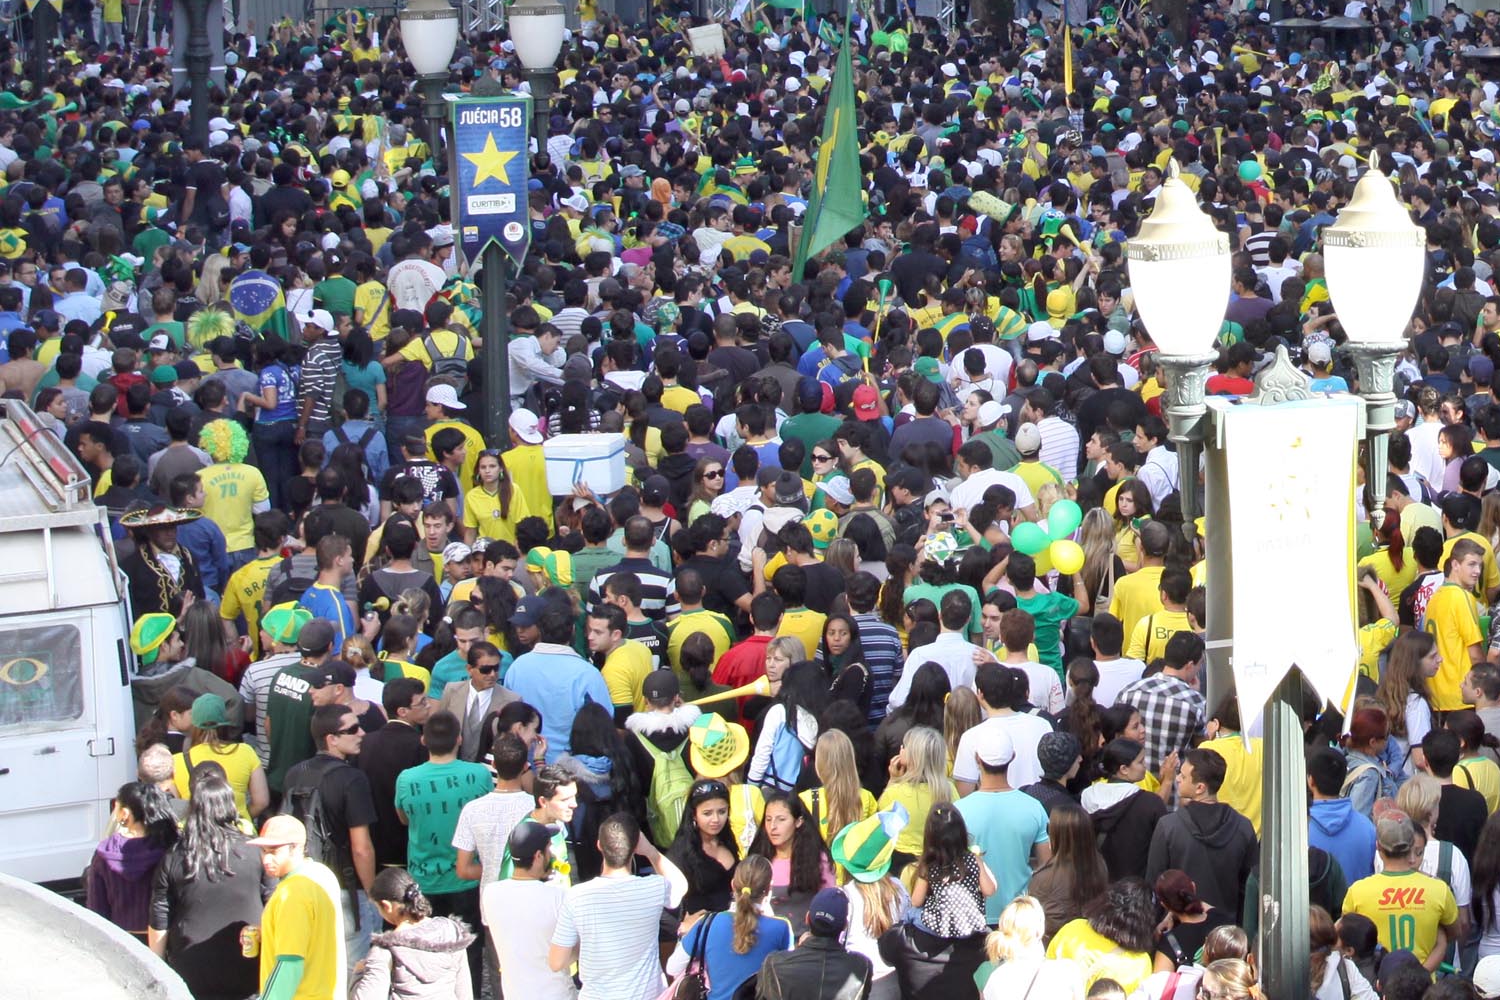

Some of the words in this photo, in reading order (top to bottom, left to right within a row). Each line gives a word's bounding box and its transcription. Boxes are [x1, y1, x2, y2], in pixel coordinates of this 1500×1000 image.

[460, 107, 499, 125] SUÉCIA
[500, 107, 522, 128] 58
[273, 685, 302, 701] CURITIBA
[276, 672, 310, 694] BAND
[1378, 887, 1426, 909] SKIL
[1388, 914, 1416, 951] 10
